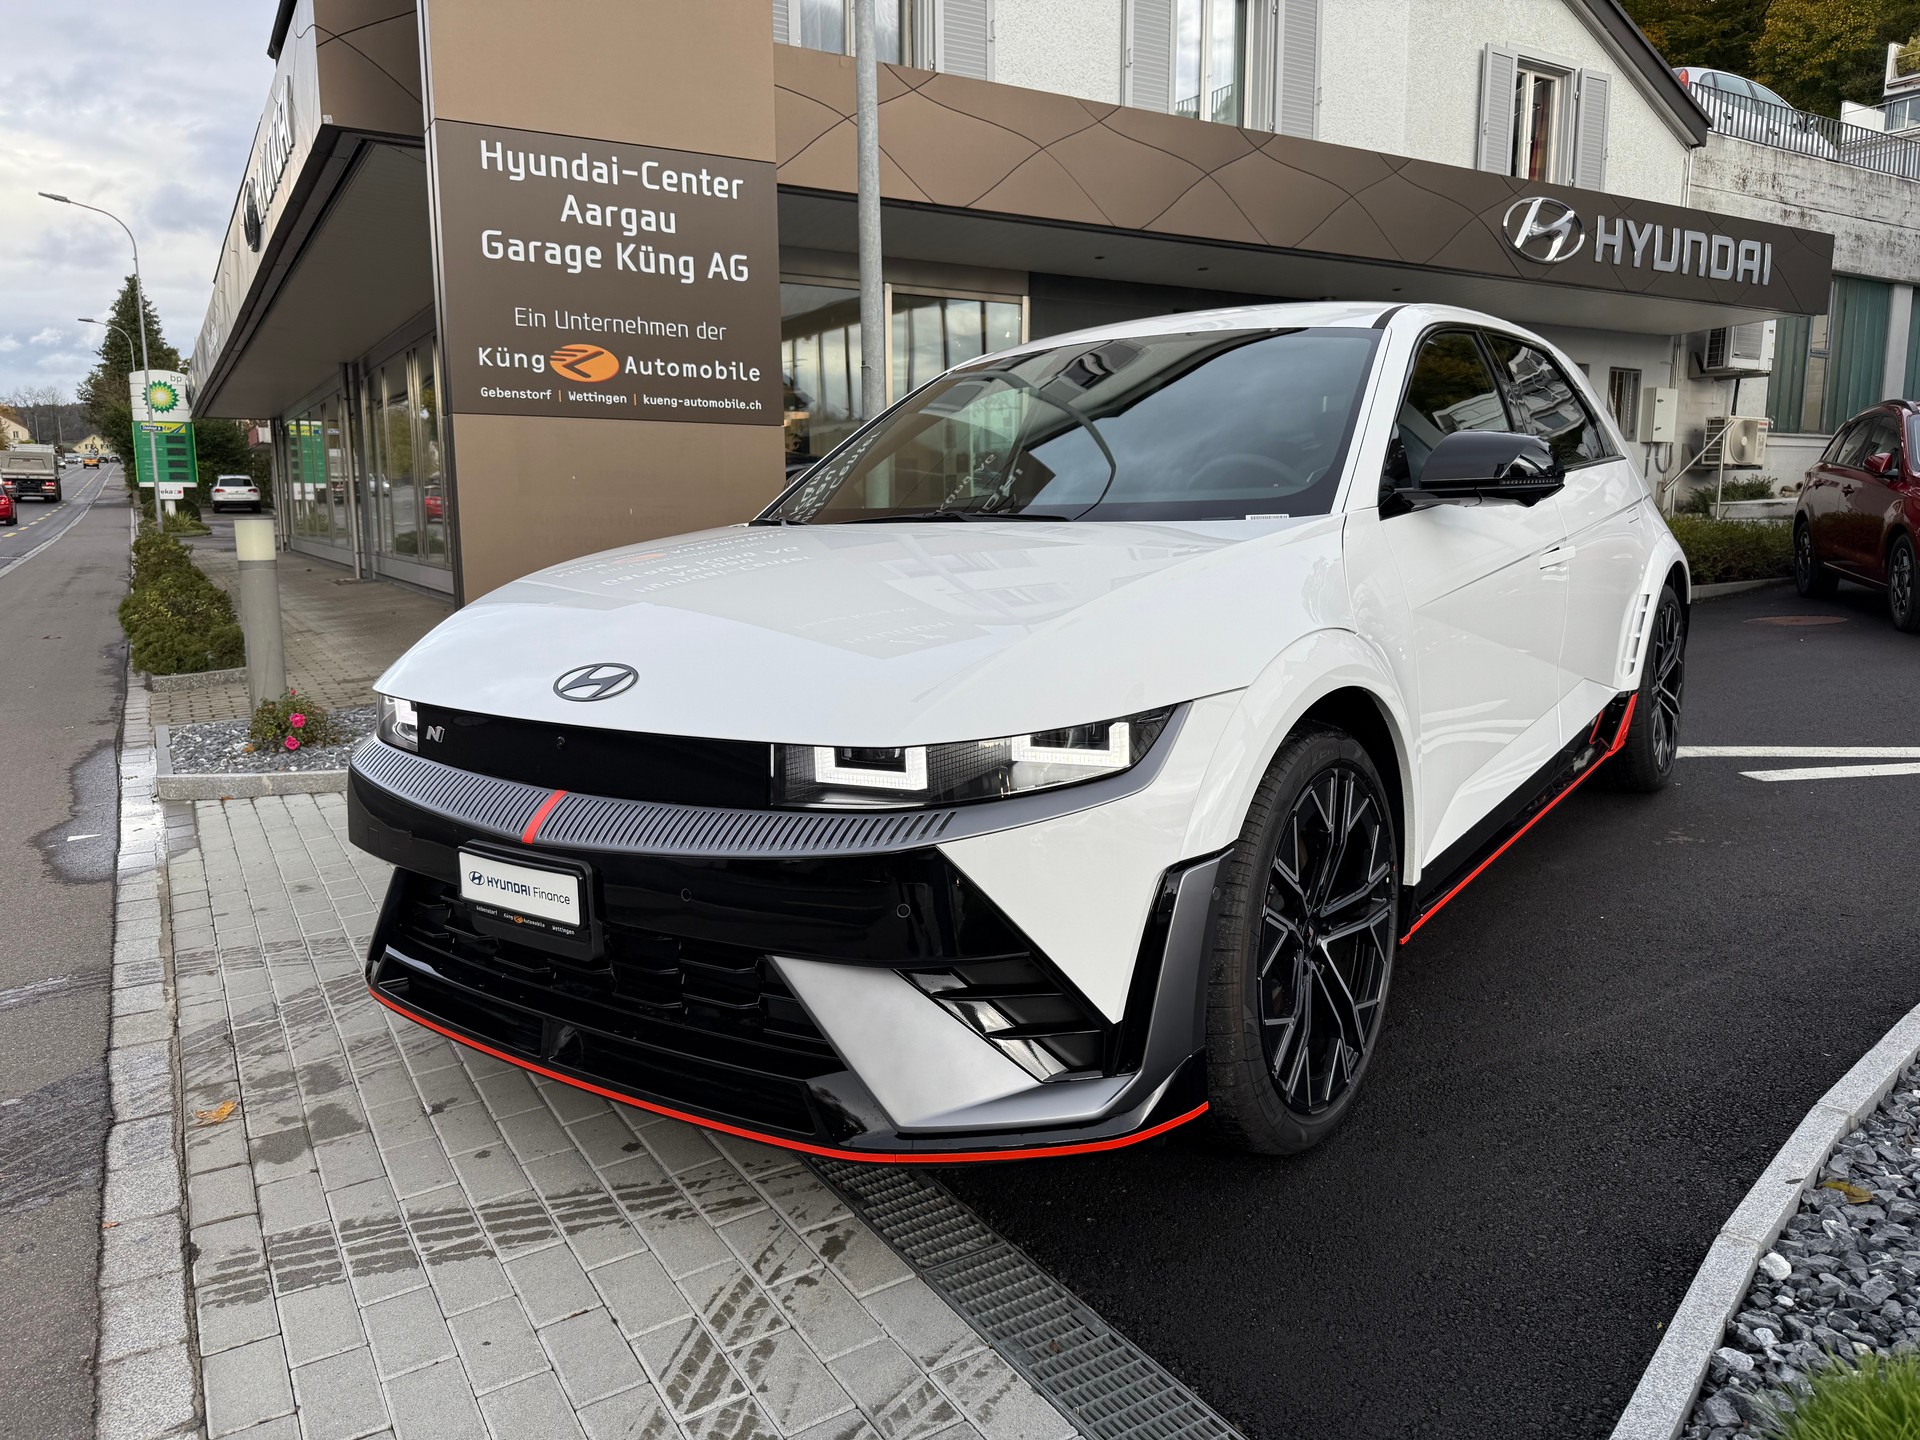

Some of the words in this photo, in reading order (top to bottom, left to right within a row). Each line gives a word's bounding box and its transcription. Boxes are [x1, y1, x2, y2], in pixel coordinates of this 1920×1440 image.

[480, 139, 744, 200] Hyundai-Center
[560, 194, 676, 237] Aargau
[481, 229, 602, 274] Garage
[616, 242, 695, 284] Küng
[707, 252, 749, 282] AG
[1595, 214, 1772, 286] HYUNDAI
[514, 306, 547, 329] Ein
[555, 309, 689, 339] Unternehmen
[696, 321, 727, 341] der
[170, 374, 182, 384] bp
[477, 346, 545, 374] Küng
[624, 355, 761, 382] Automobile
[480, 386, 552, 401] Gebenstorf
[568, 390, 627, 405] Wettingen
[643, 394, 762, 411] kueng-automobile.ch
[426, 725, 445, 743] N
[486, 875, 531, 897] HYUNDAI
[533, 886, 571, 905] Finance
